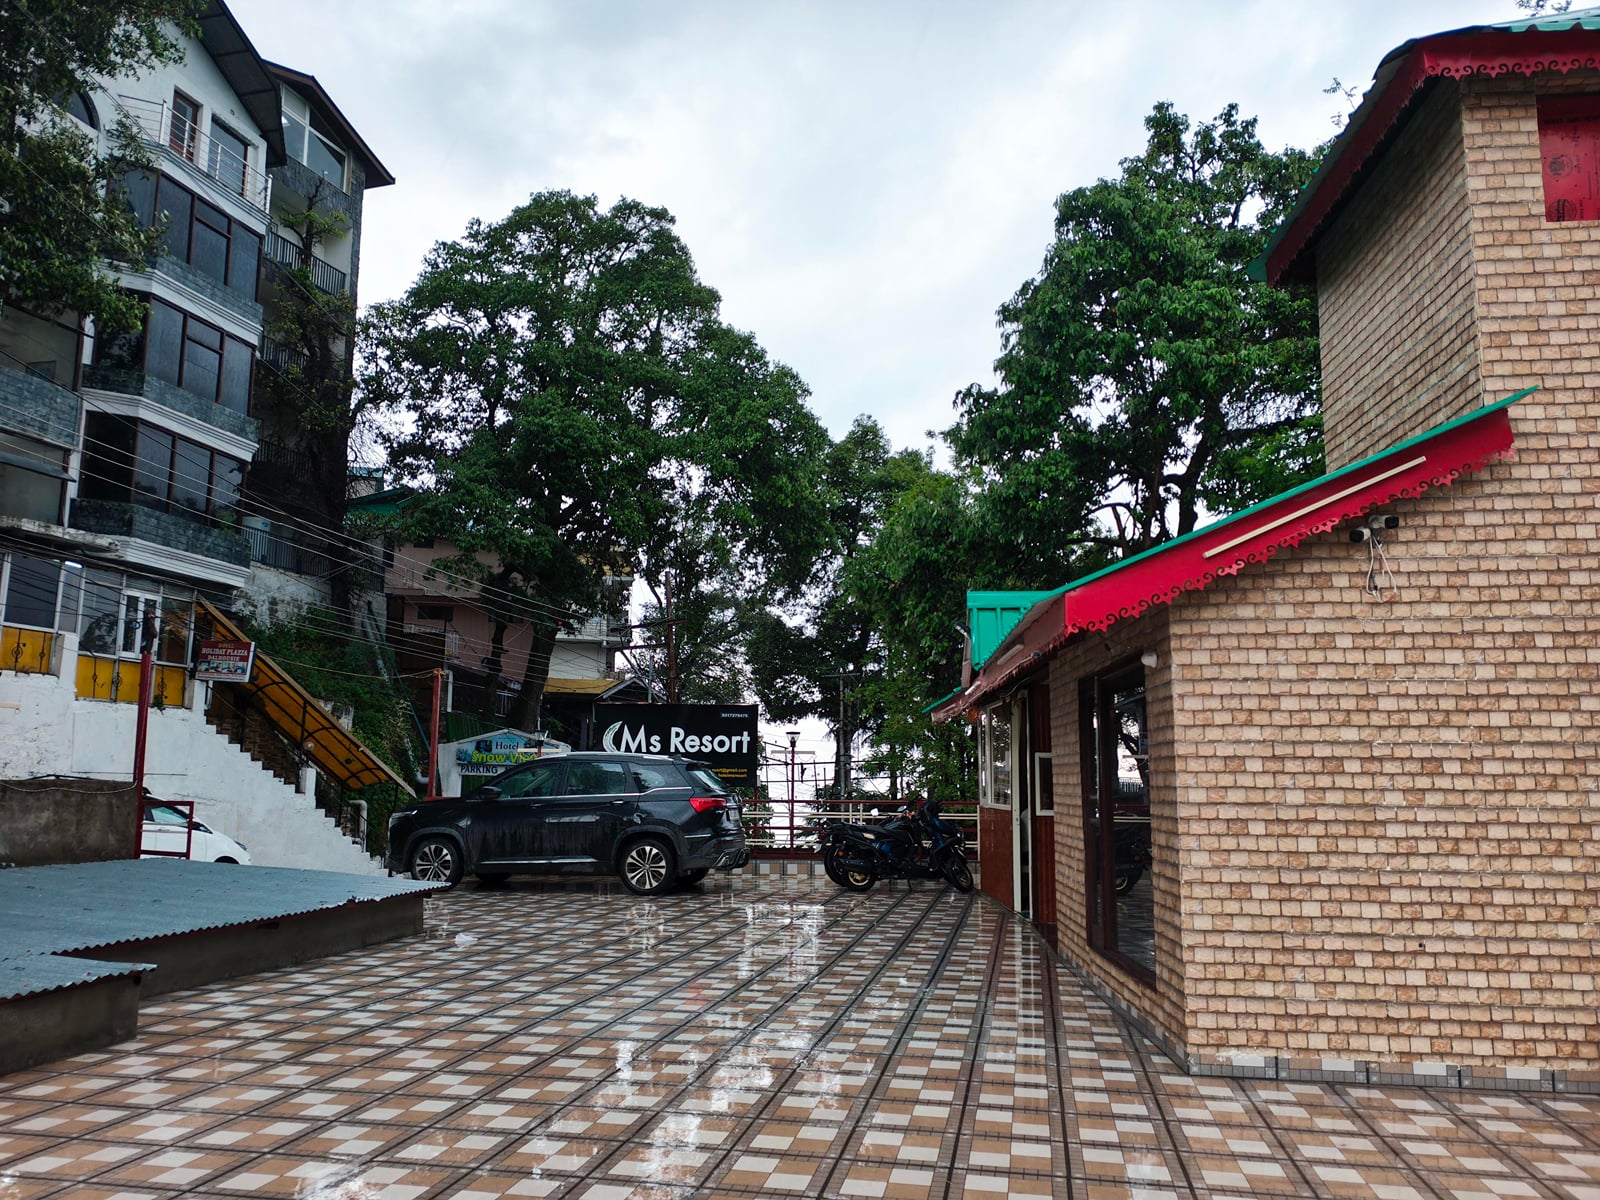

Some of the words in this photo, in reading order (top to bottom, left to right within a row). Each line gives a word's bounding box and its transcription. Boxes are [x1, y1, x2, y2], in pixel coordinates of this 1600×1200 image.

[619, 724, 662, 753] Ms
[670, 726, 751, 754] Resort
[495, 741, 519, 750] Hotel
[471, 750, 506, 763] Snow
[460, 765, 498, 774] PARKING
